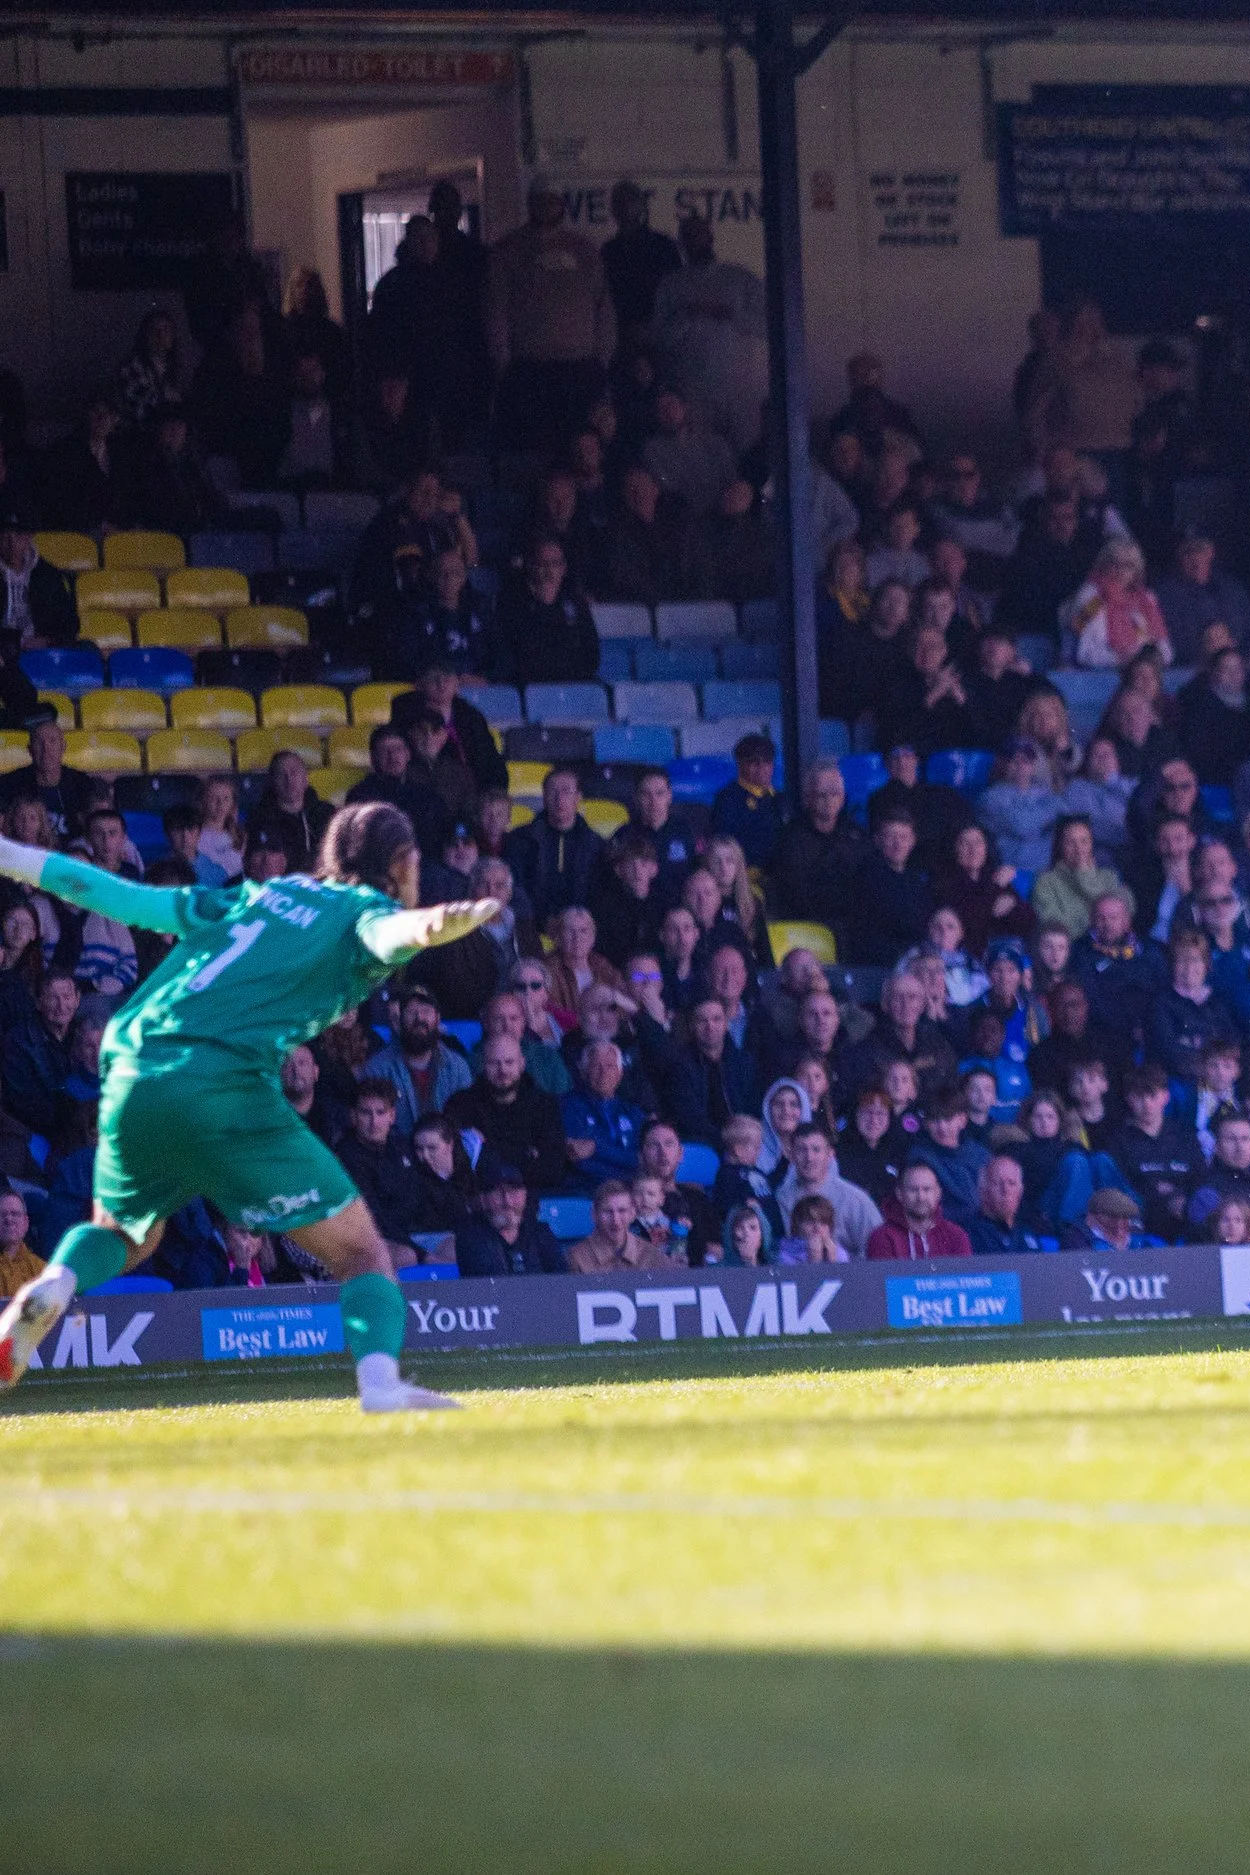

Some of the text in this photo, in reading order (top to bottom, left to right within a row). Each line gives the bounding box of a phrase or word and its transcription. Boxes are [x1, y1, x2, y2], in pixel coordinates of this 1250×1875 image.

[380, 54, 463, 78] TOILET
[188, 919, 267, 992] 1
[1081, 1267, 1169, 1302] Your
[408, 1299, 500, 1334] Your
[902, 1291, 1007, 1320] Best Law
[219, 1323, 329, 1352] Best Law
